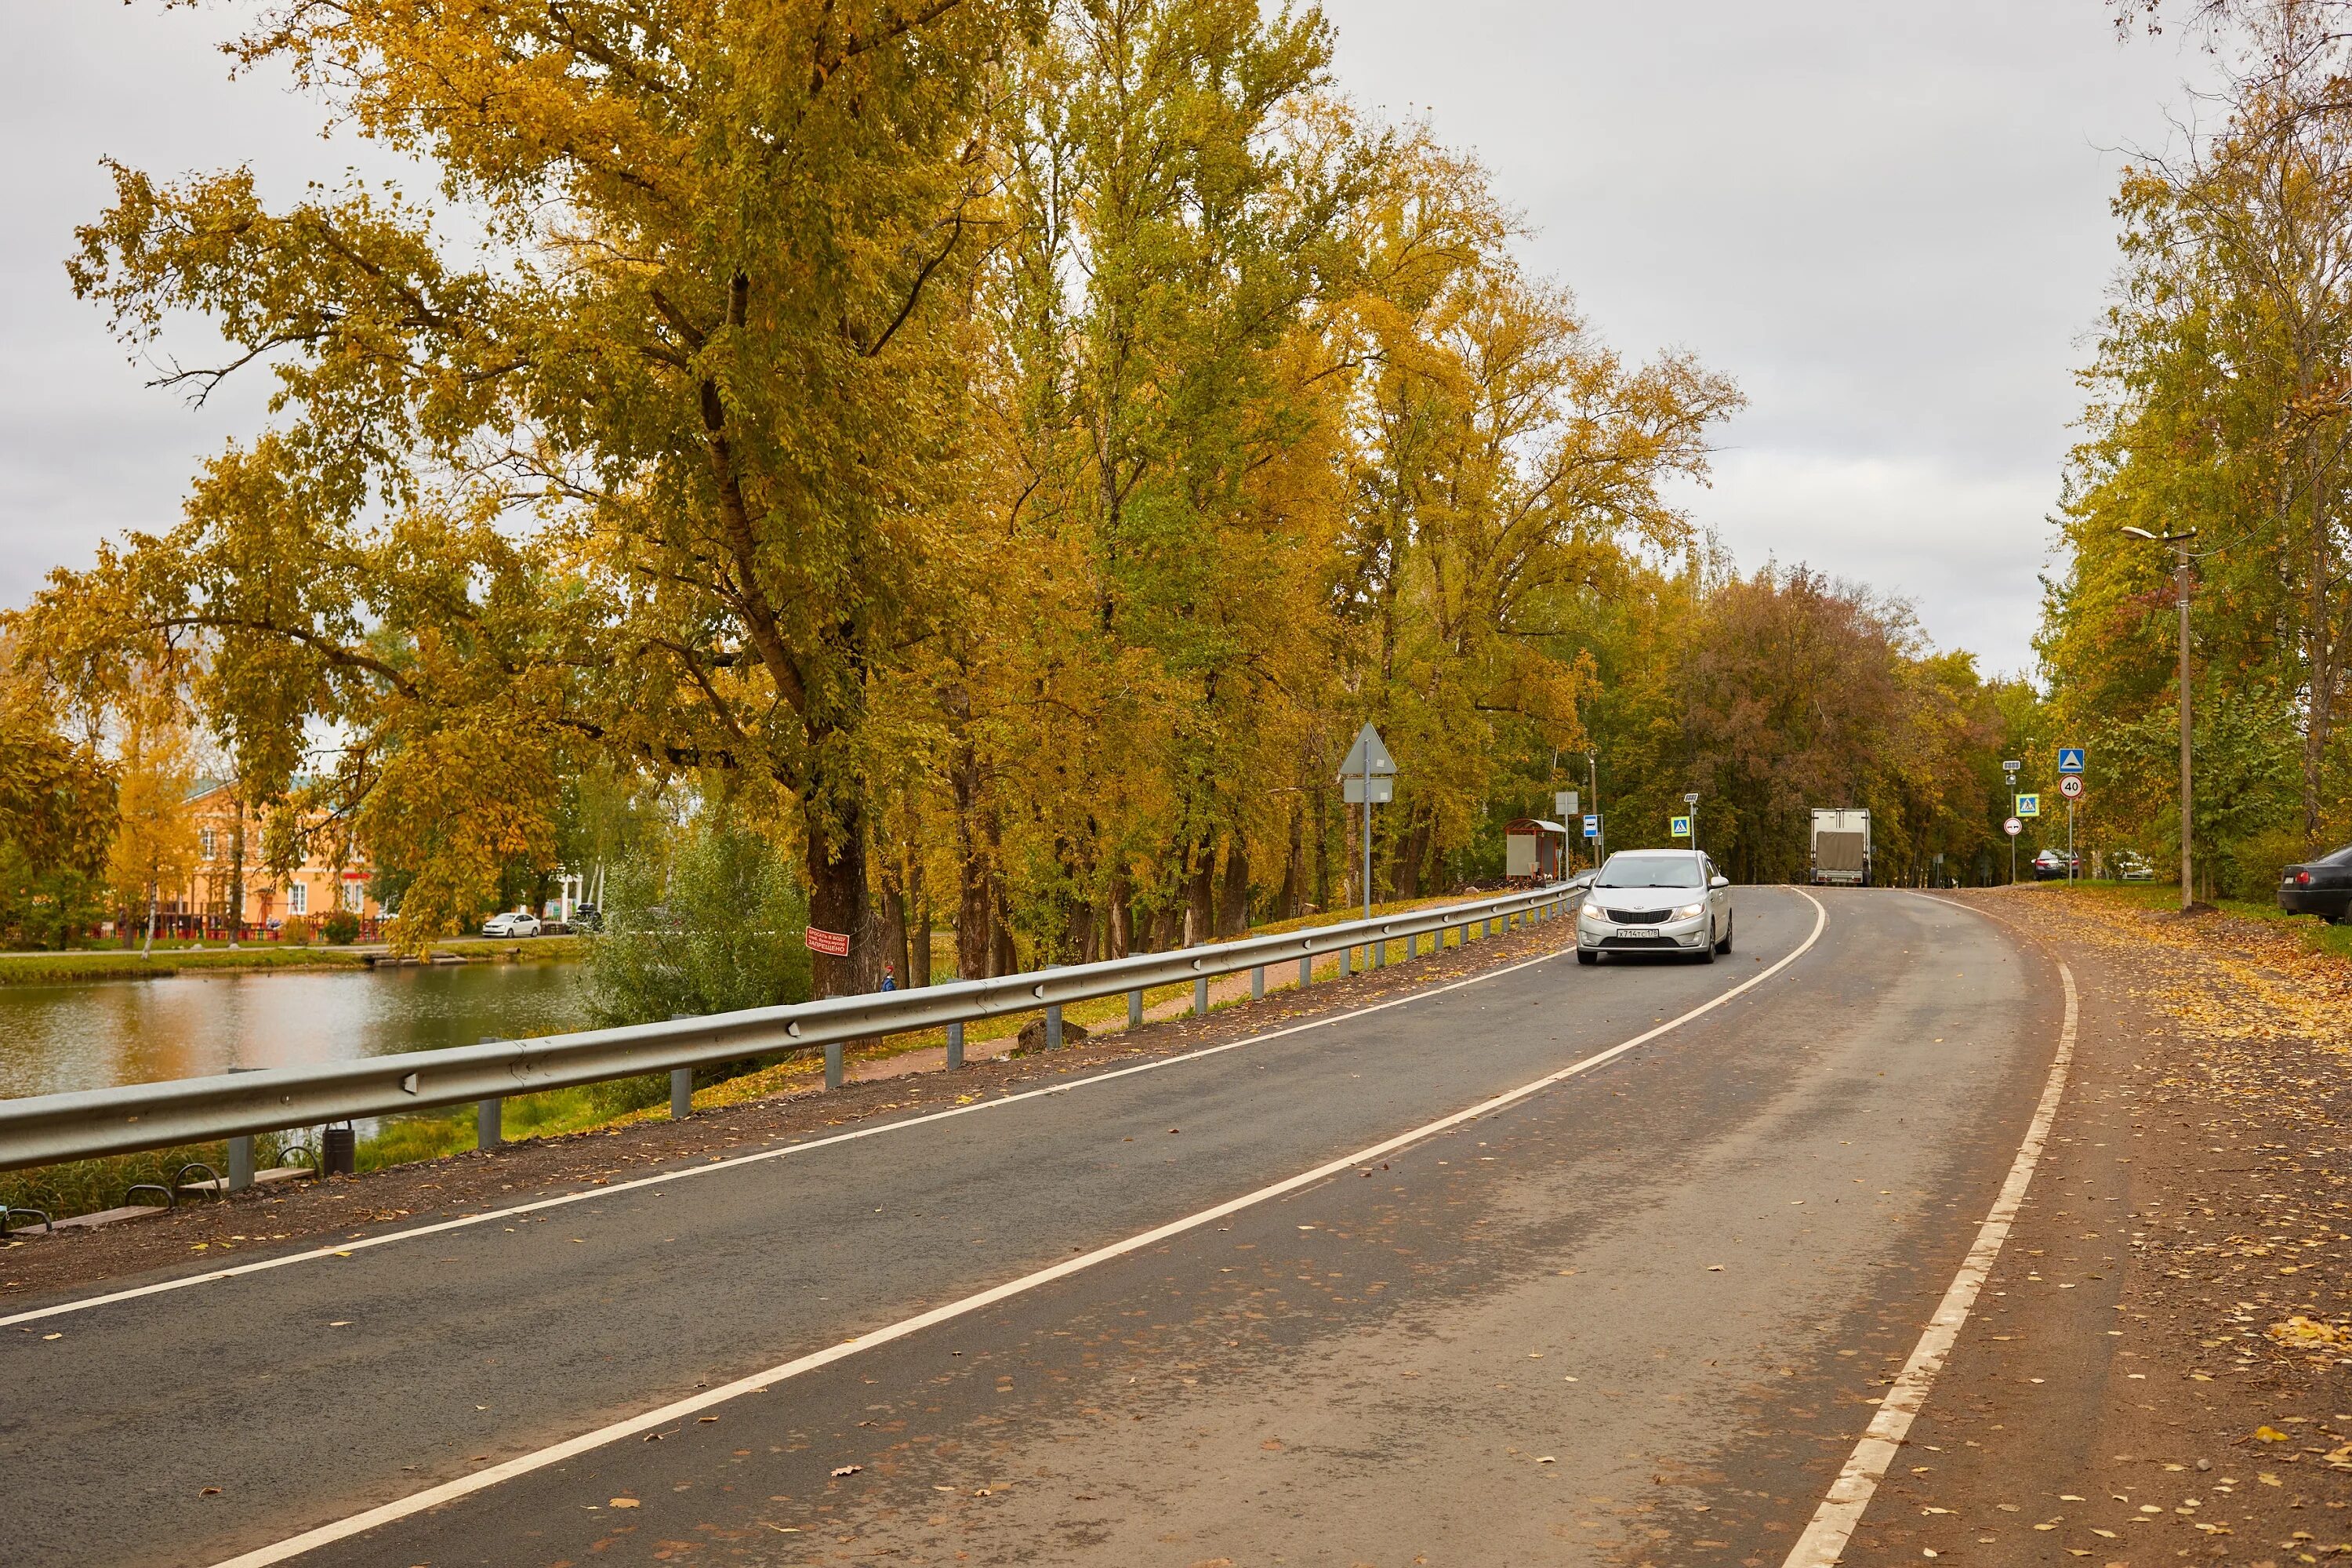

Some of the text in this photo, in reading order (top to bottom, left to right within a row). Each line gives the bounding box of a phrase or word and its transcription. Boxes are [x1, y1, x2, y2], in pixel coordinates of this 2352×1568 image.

[2064, 782, 2078, 791] 40
[808, 929, 828, 938] БРОСАТЬ
[808, 939, 845, 952] ЗАПРЕЩЕНО
